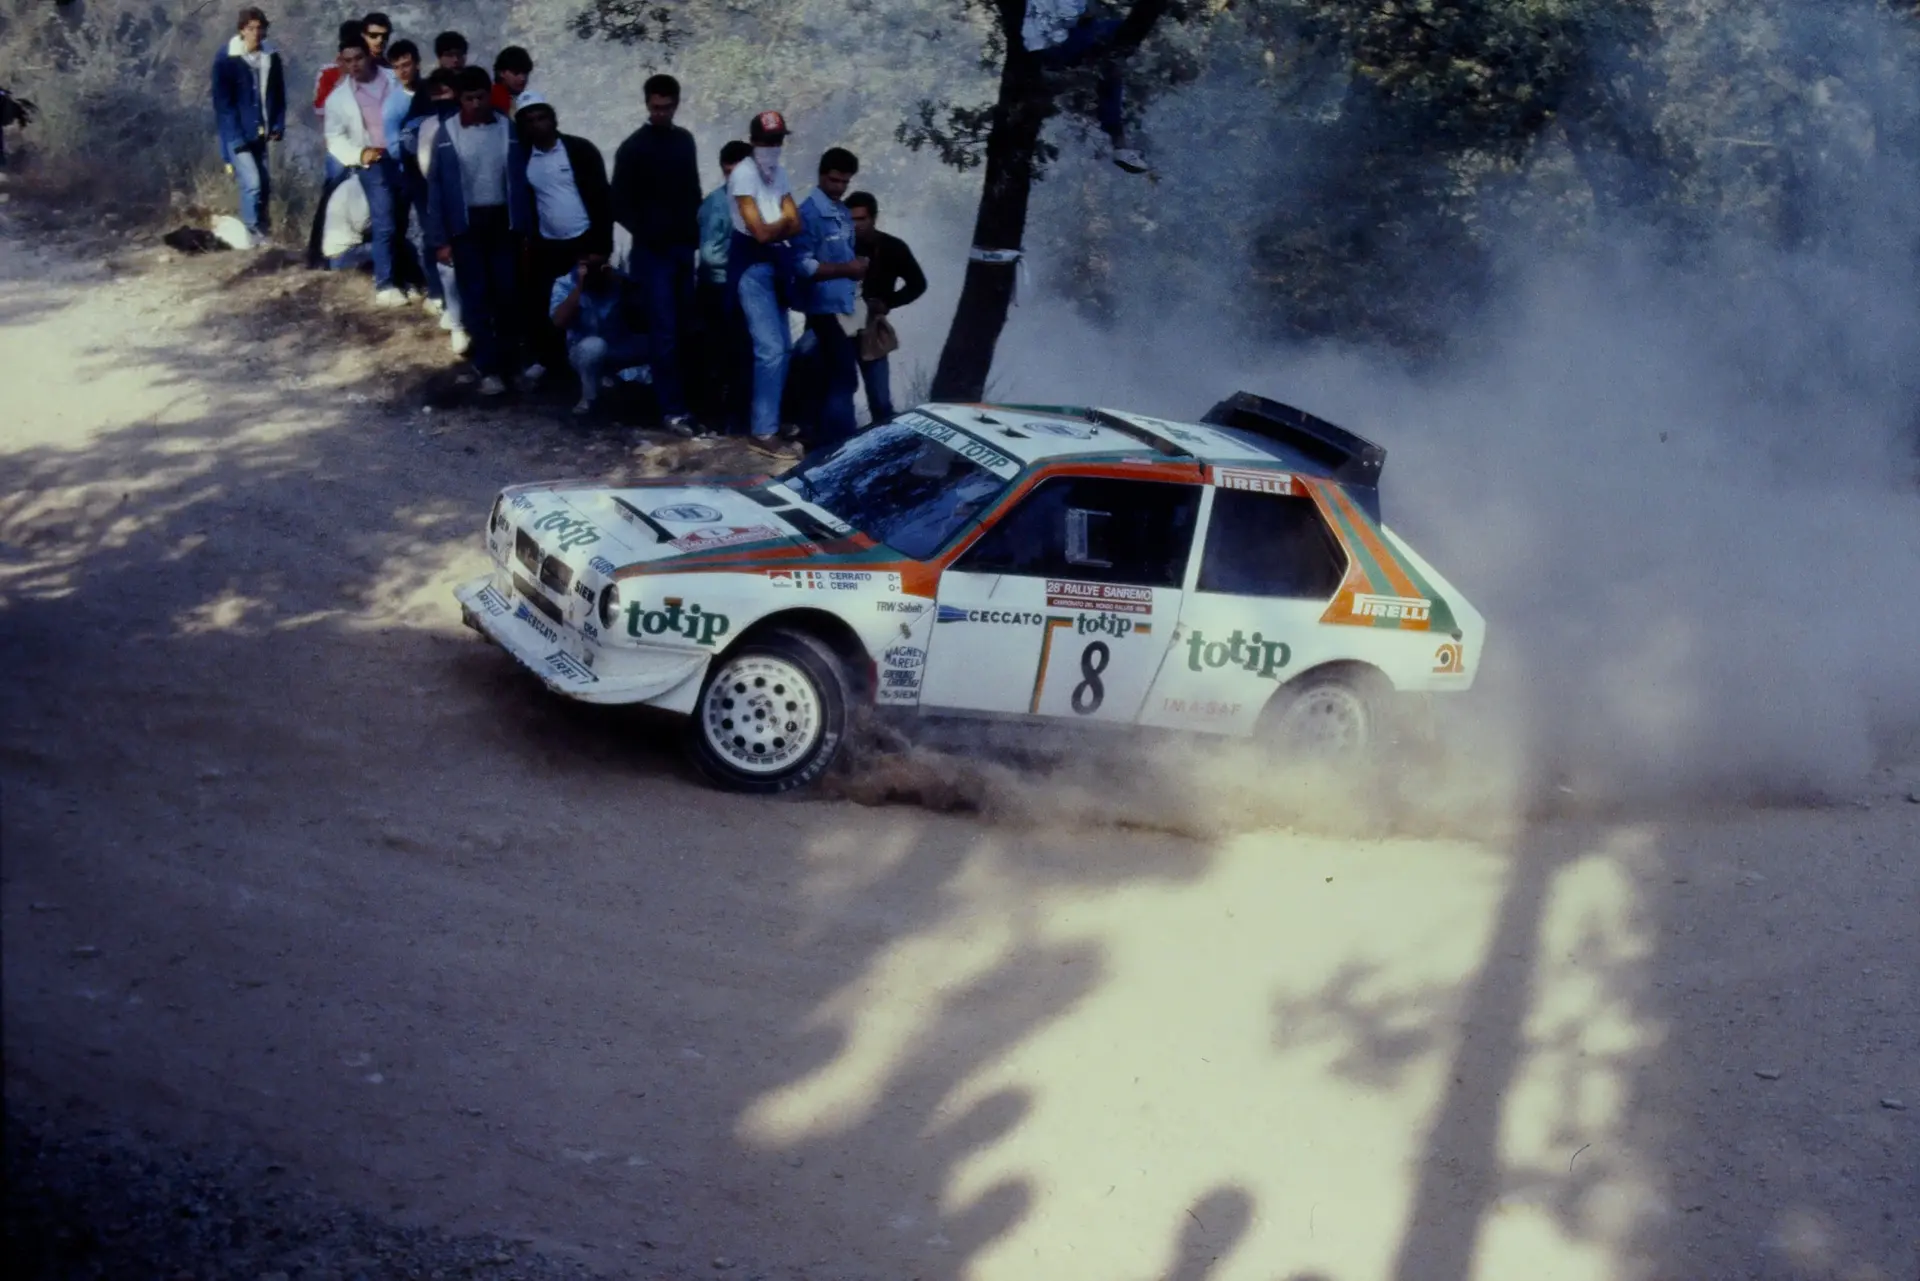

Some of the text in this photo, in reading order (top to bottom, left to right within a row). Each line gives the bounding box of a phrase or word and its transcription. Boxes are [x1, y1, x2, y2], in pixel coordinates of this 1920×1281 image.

[905, 415, 1010, 467] LANCIA TOTIP
[1213, 466, 1292, 495] PIRELLI
[534, 510, 600, 552] totip
[829, 572, 872, 581] CERRATO
[830, 581, 858, 590] CERRI
[1063, 583, 1099, 596] RALLYE
[1103, 586, 1152, 600] SANREMO
[876, 601, 896, 612] TRW
[969, 610, 1043, 626] CECCATO
[1352, 593, 1431, 621] PIRELLI
[624, 597, 730, 646] totip
[1077, 612, 1132, 638] totip
[1186, 630, 1291, 678] totip
[1071, 640, 1110, 716] 8
